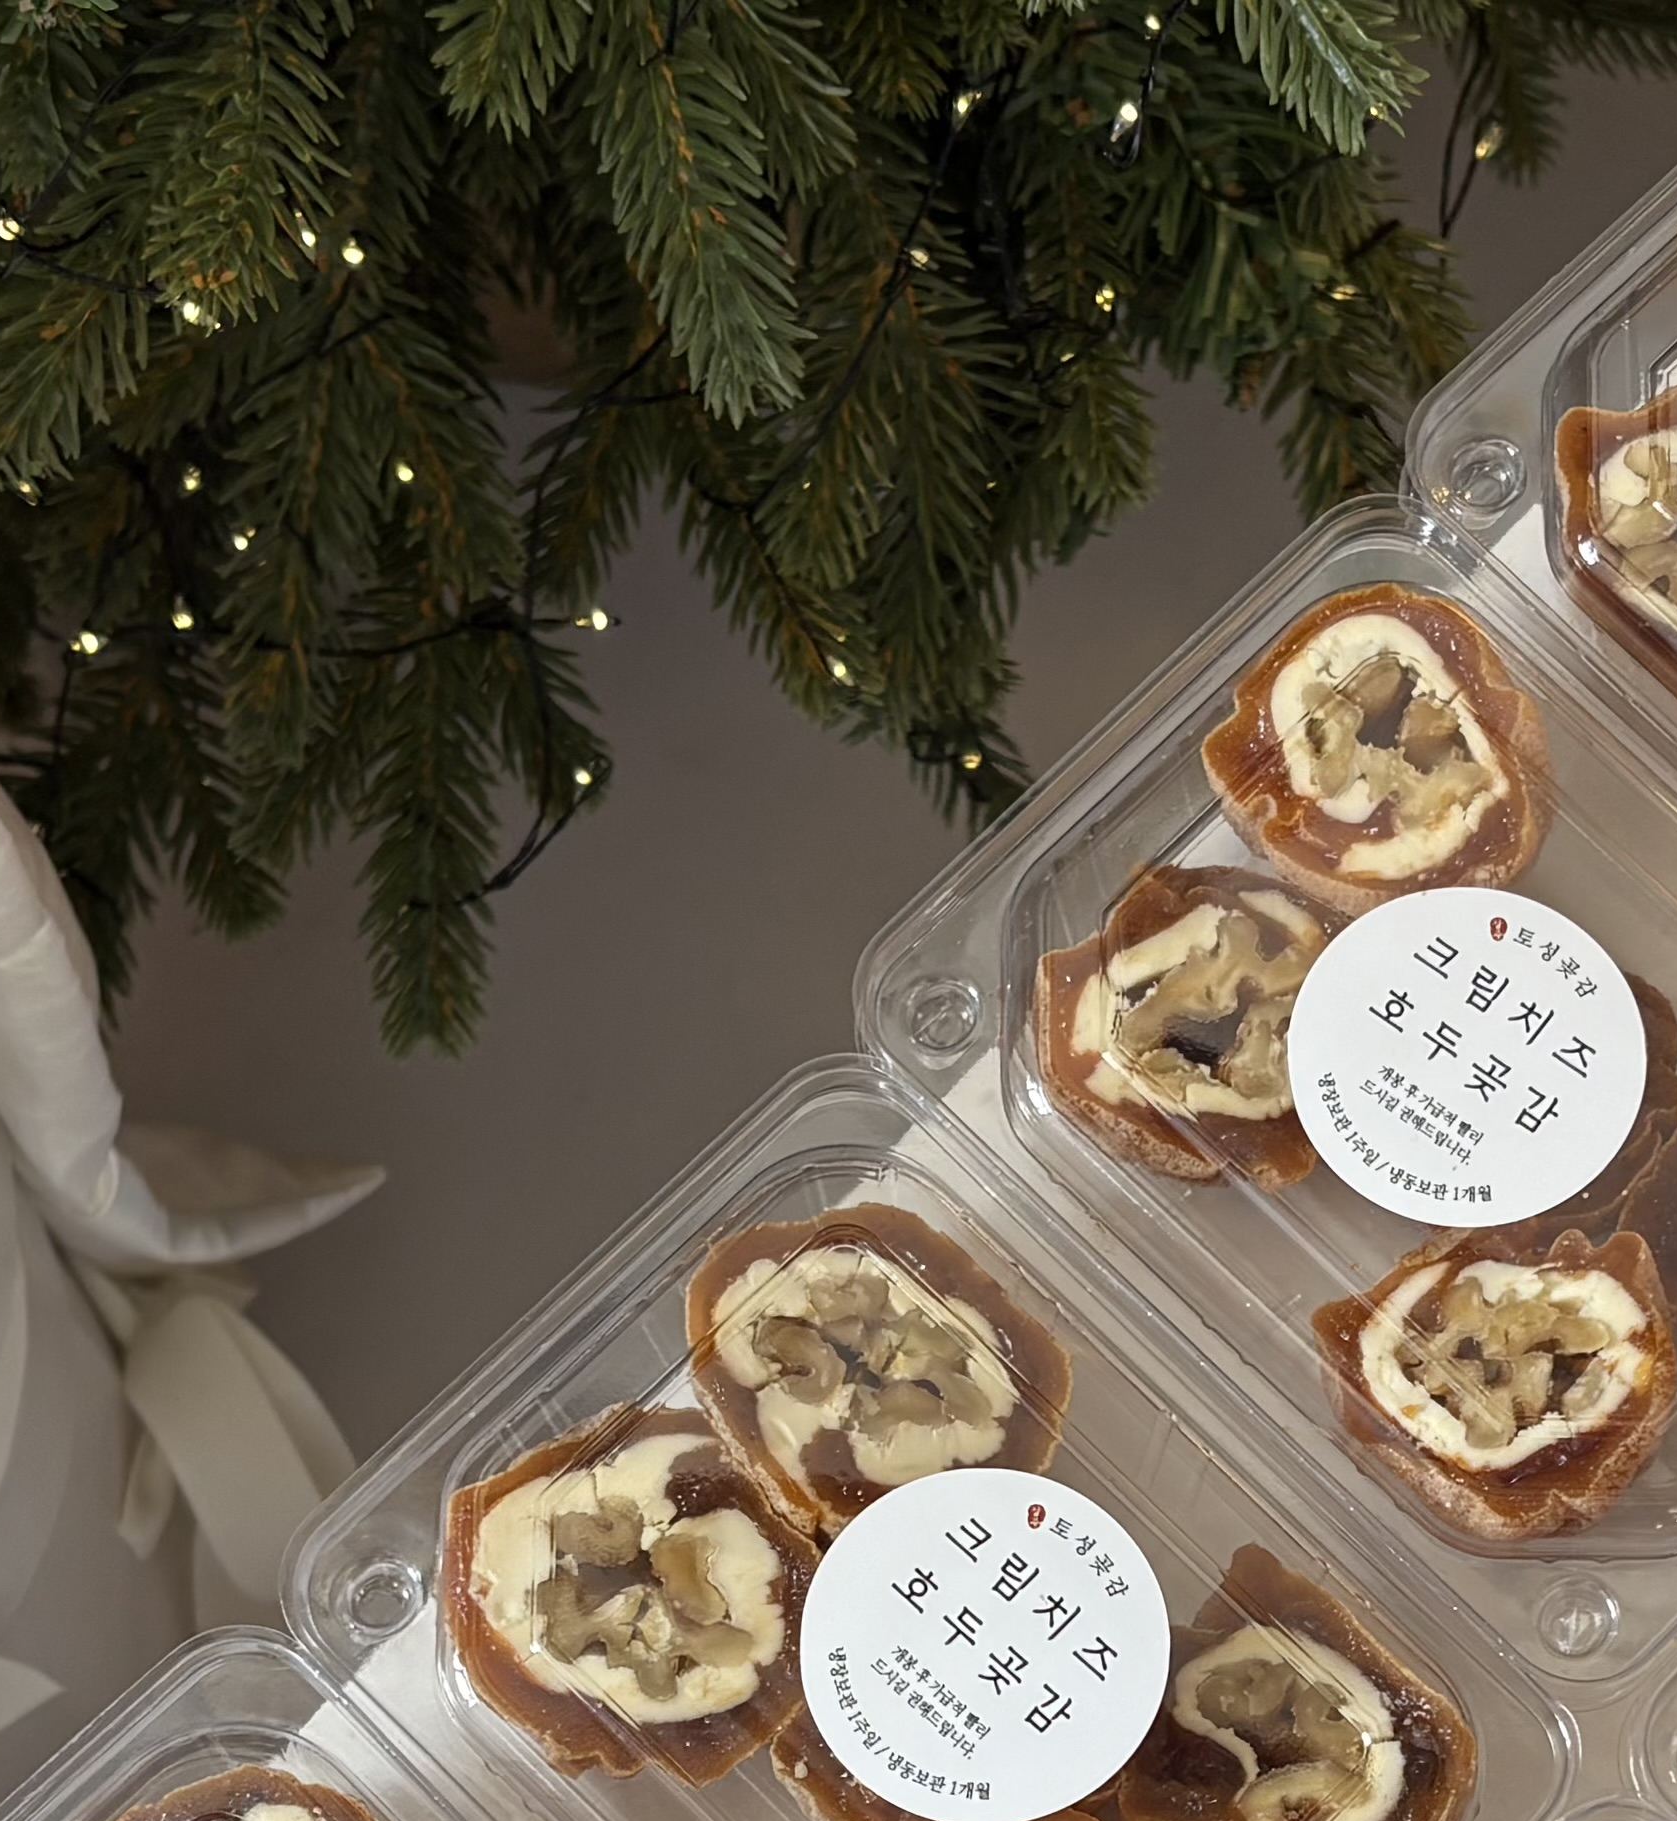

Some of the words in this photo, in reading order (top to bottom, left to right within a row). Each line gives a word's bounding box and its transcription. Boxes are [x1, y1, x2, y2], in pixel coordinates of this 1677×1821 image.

[1413, 936, 1597, 1079] 크림치즈
[1512, 927, 1598, 998] 토성곶감
[1359, 1079, 1400, 1113] 드시길
[1368, 989, 1559, 1134] 호두곶감
[1378, 1065, 1405, 1089] 개봉
[1404, 1084, 1420, 1099] 후
[1418, 1094, 1459, 1128] 가급적
[1317, 1072, 1353, 1133] 냉장보관
[1344, 1131, 1381, 1167] 1주일
[1389, 1166, 1448, 1201] 냉동보관
[1453, 1184, 1492, 1203] 1개월
[945, 1517, 1118, 1682] 크림치즈
[1048, 1517, 1129, 1597] 토성곶감
[870, 1658, 911, 1696] 드시길
[891, 1567, 1073, 1734] 호두곶감
[891, 1645, 919, 1672] 개봉
[915, 1668, 932, 1684] 후
[928, 1680, 968, 1718] 가급적
[828, 1646, 858, 1710] 냉장보관
[847, 1710, 882, 1750] 1주일
[887, 1751, 946, 1794] 냉동보관
[949, 1780, 990, 1801] 1개월
